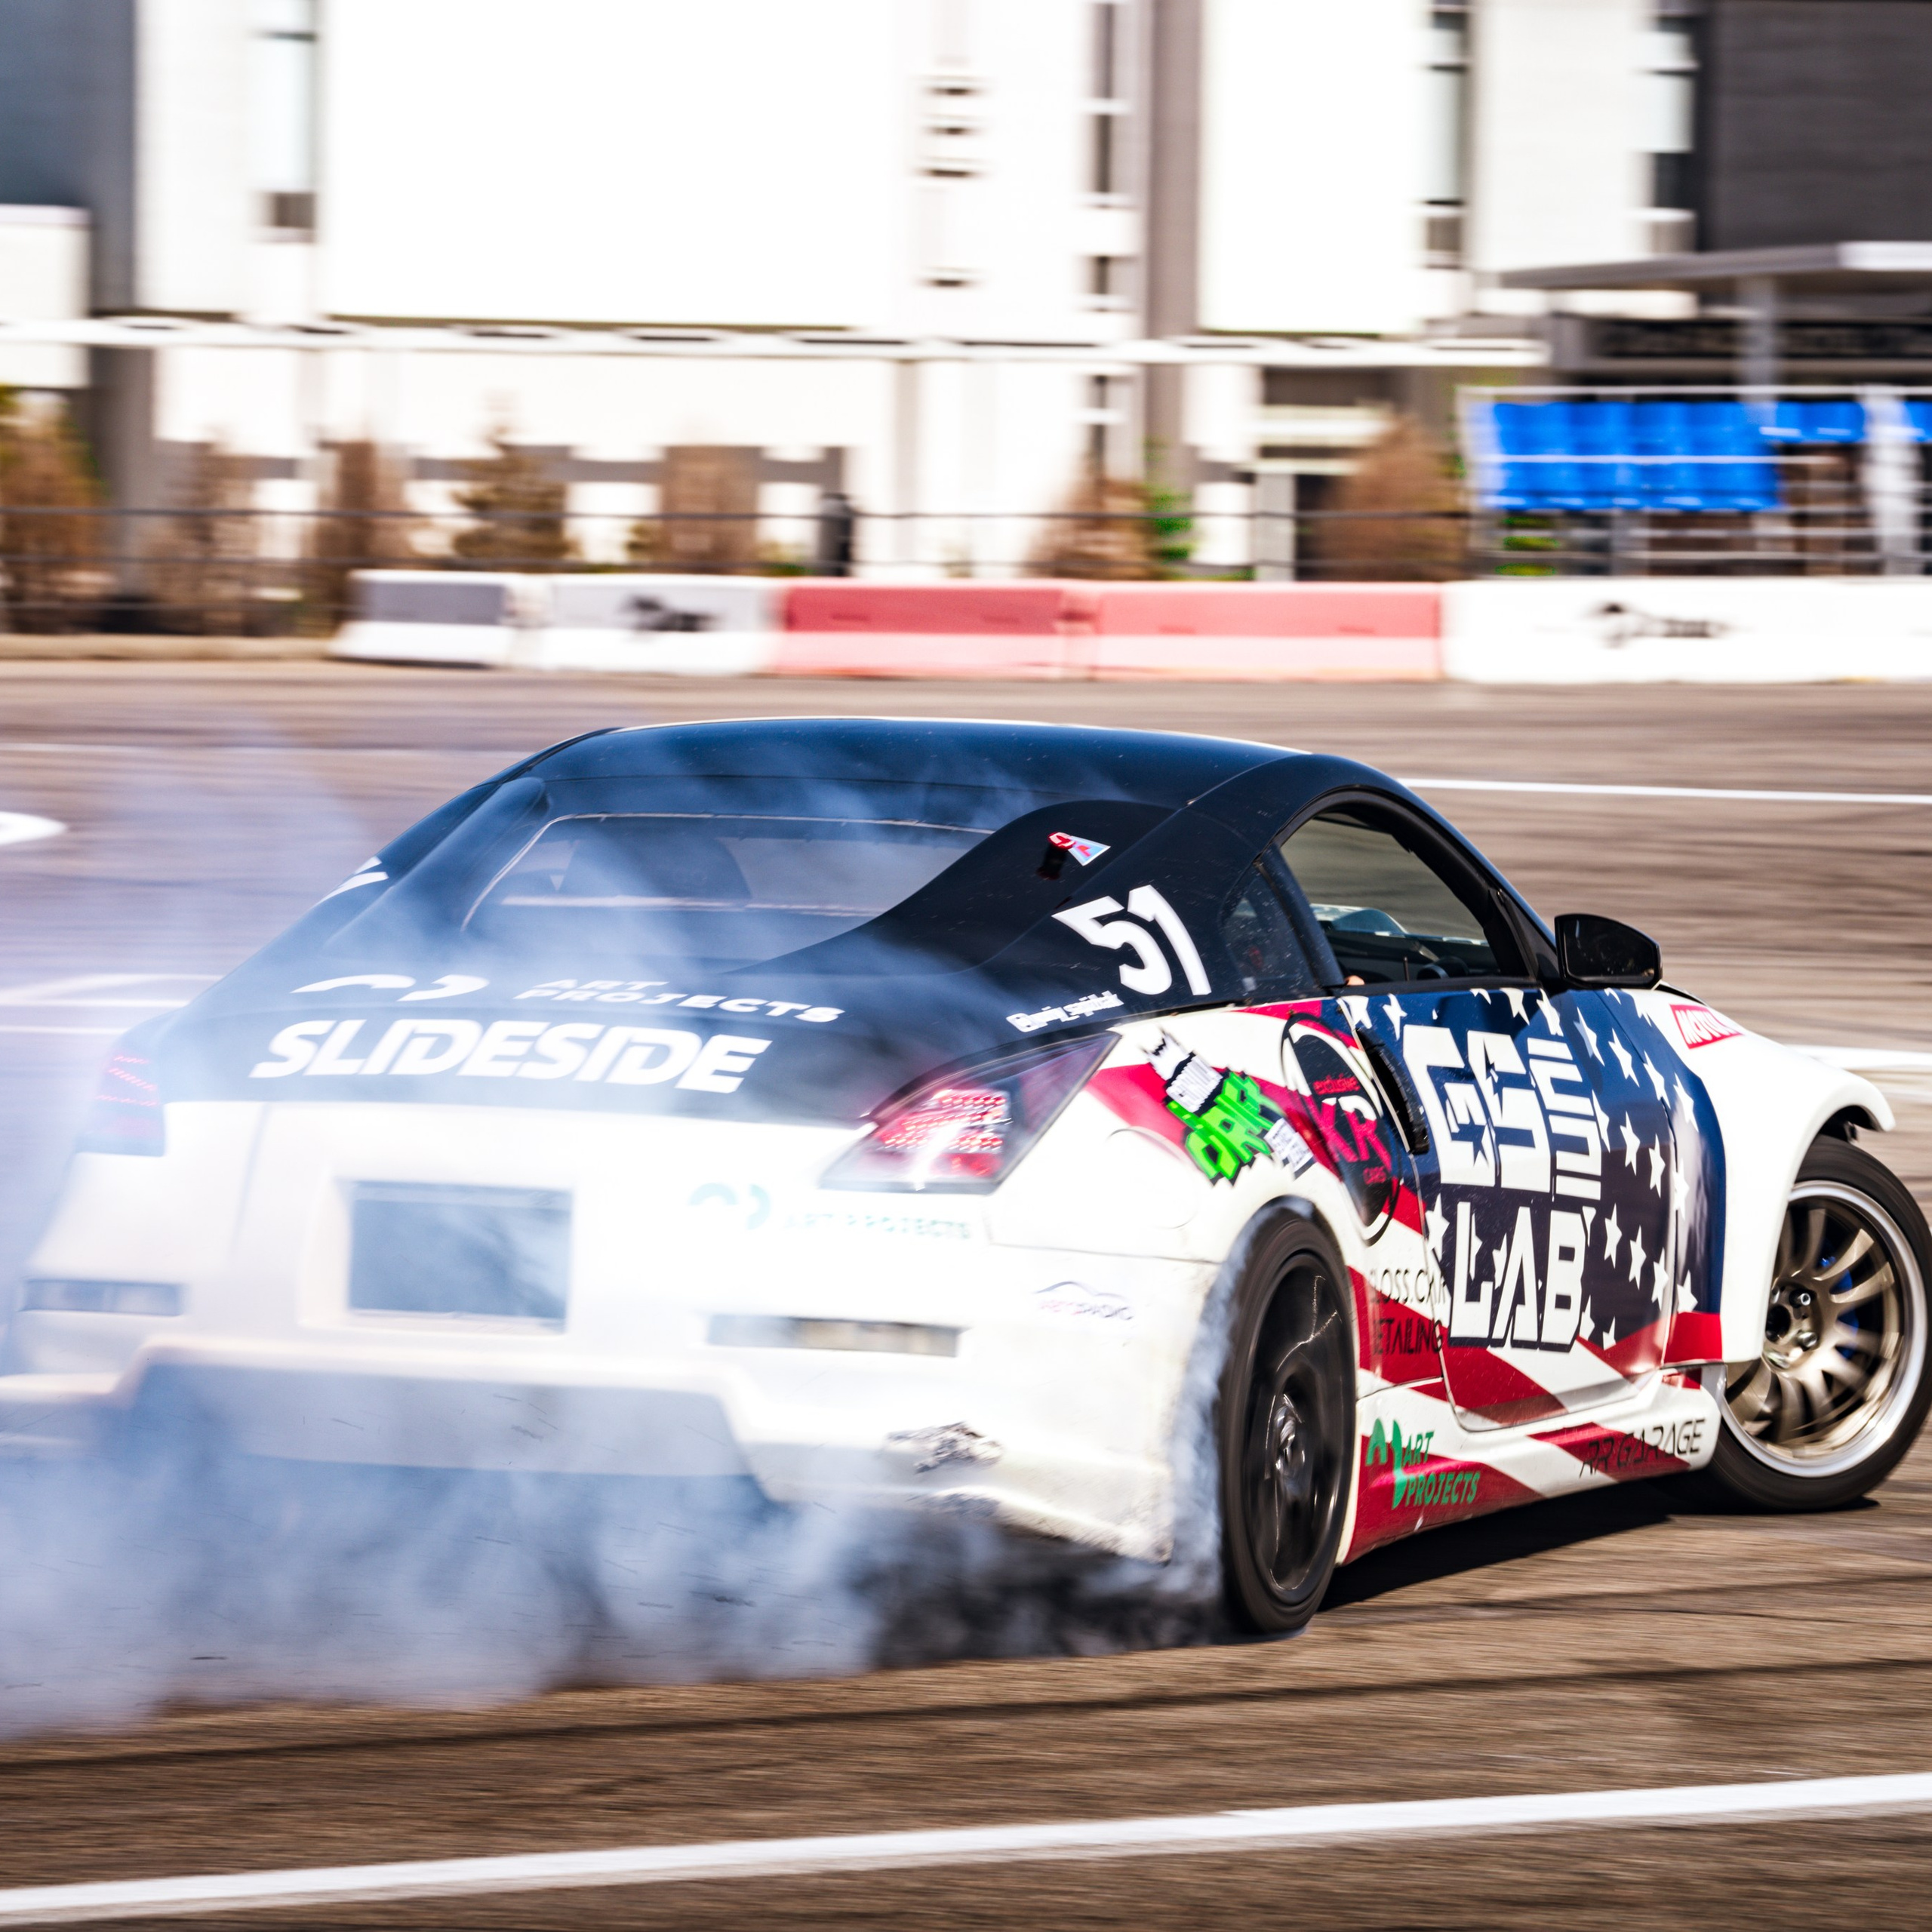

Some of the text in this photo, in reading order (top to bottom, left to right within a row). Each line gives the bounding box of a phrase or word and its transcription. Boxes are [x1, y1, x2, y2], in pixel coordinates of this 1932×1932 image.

[1051, 884, 1211, 995] 51
[512, 989, 846, 1023] PROJECTS
[532, 979, 670, 992] ART
[250, 1020, 772, 1092] SLIDESIDE
[1451, 1201, 1586, 1345] LAB
[1402, 1429, 1435, 1467] ART
[1617, 1419, 1705, 1467] GARAGE
[1405, 1472, 1480, 1506] PROJECTS
